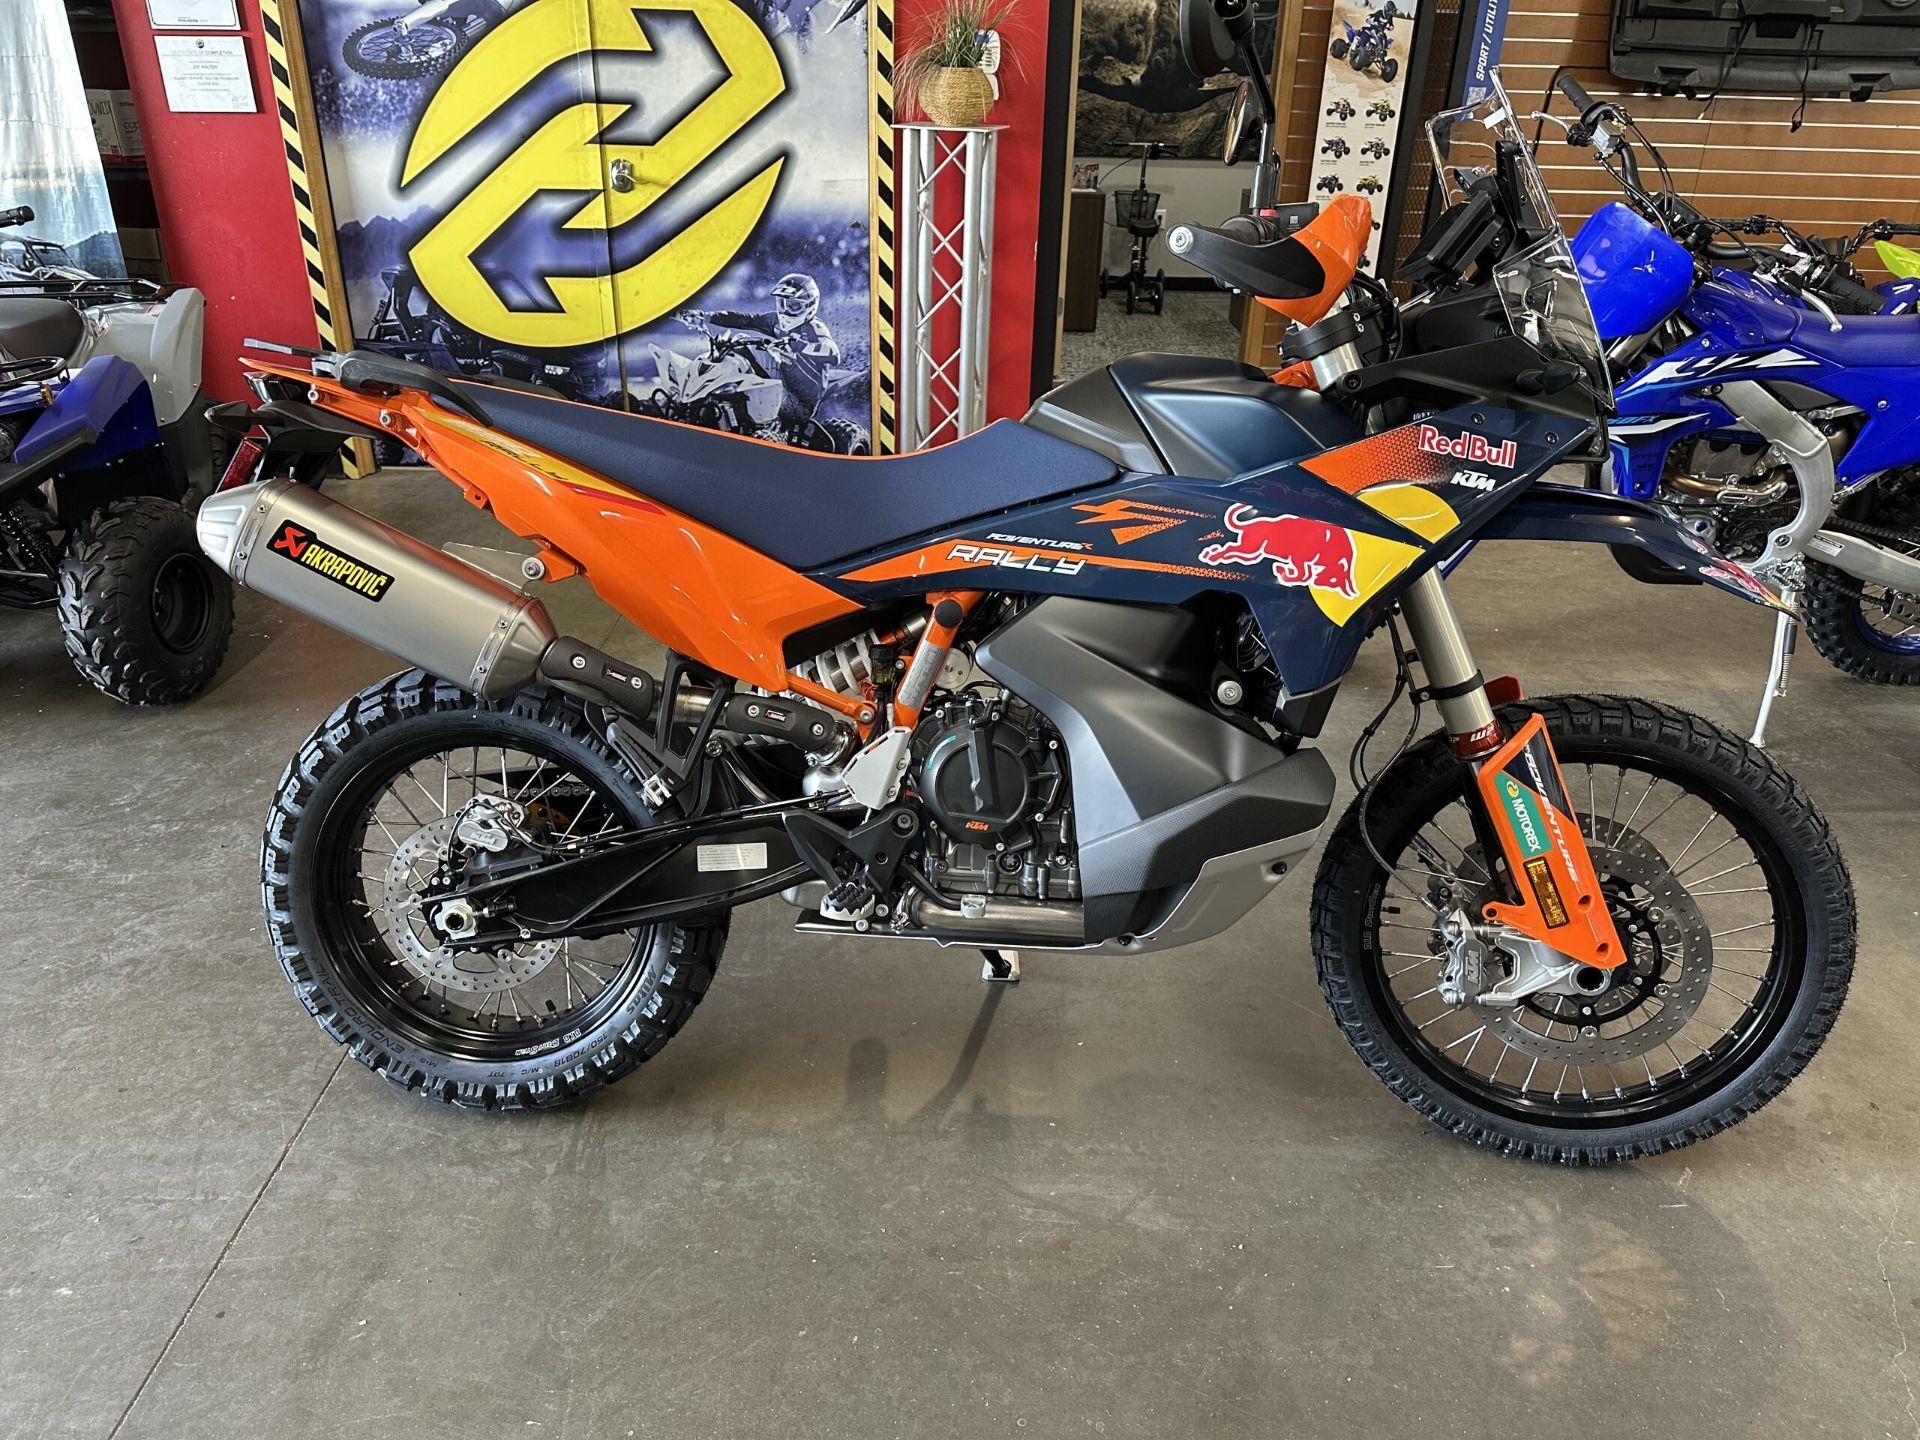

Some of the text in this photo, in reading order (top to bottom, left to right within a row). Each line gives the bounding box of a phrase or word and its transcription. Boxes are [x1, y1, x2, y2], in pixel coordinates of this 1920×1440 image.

[1482, 33, 1491, 44] /
[1476, 43, 1490, 81] SPORT
[1418, 424, 1517, 469] Red Bull
[1450, 470, 1496, 491] KTM
[986, 533, 1083, 550] ADVENTURE
[947, 544, 1086, 575] RALLY
[965, 820, 989, 831] KTM
[1512, 797, 1542, 853] MOTOREX
[1524, 751, 1580, 883] ADVENTURE
[1465, 950, 1479, 984] KTM
[344, 1006, 405, 1054] ENDURO
